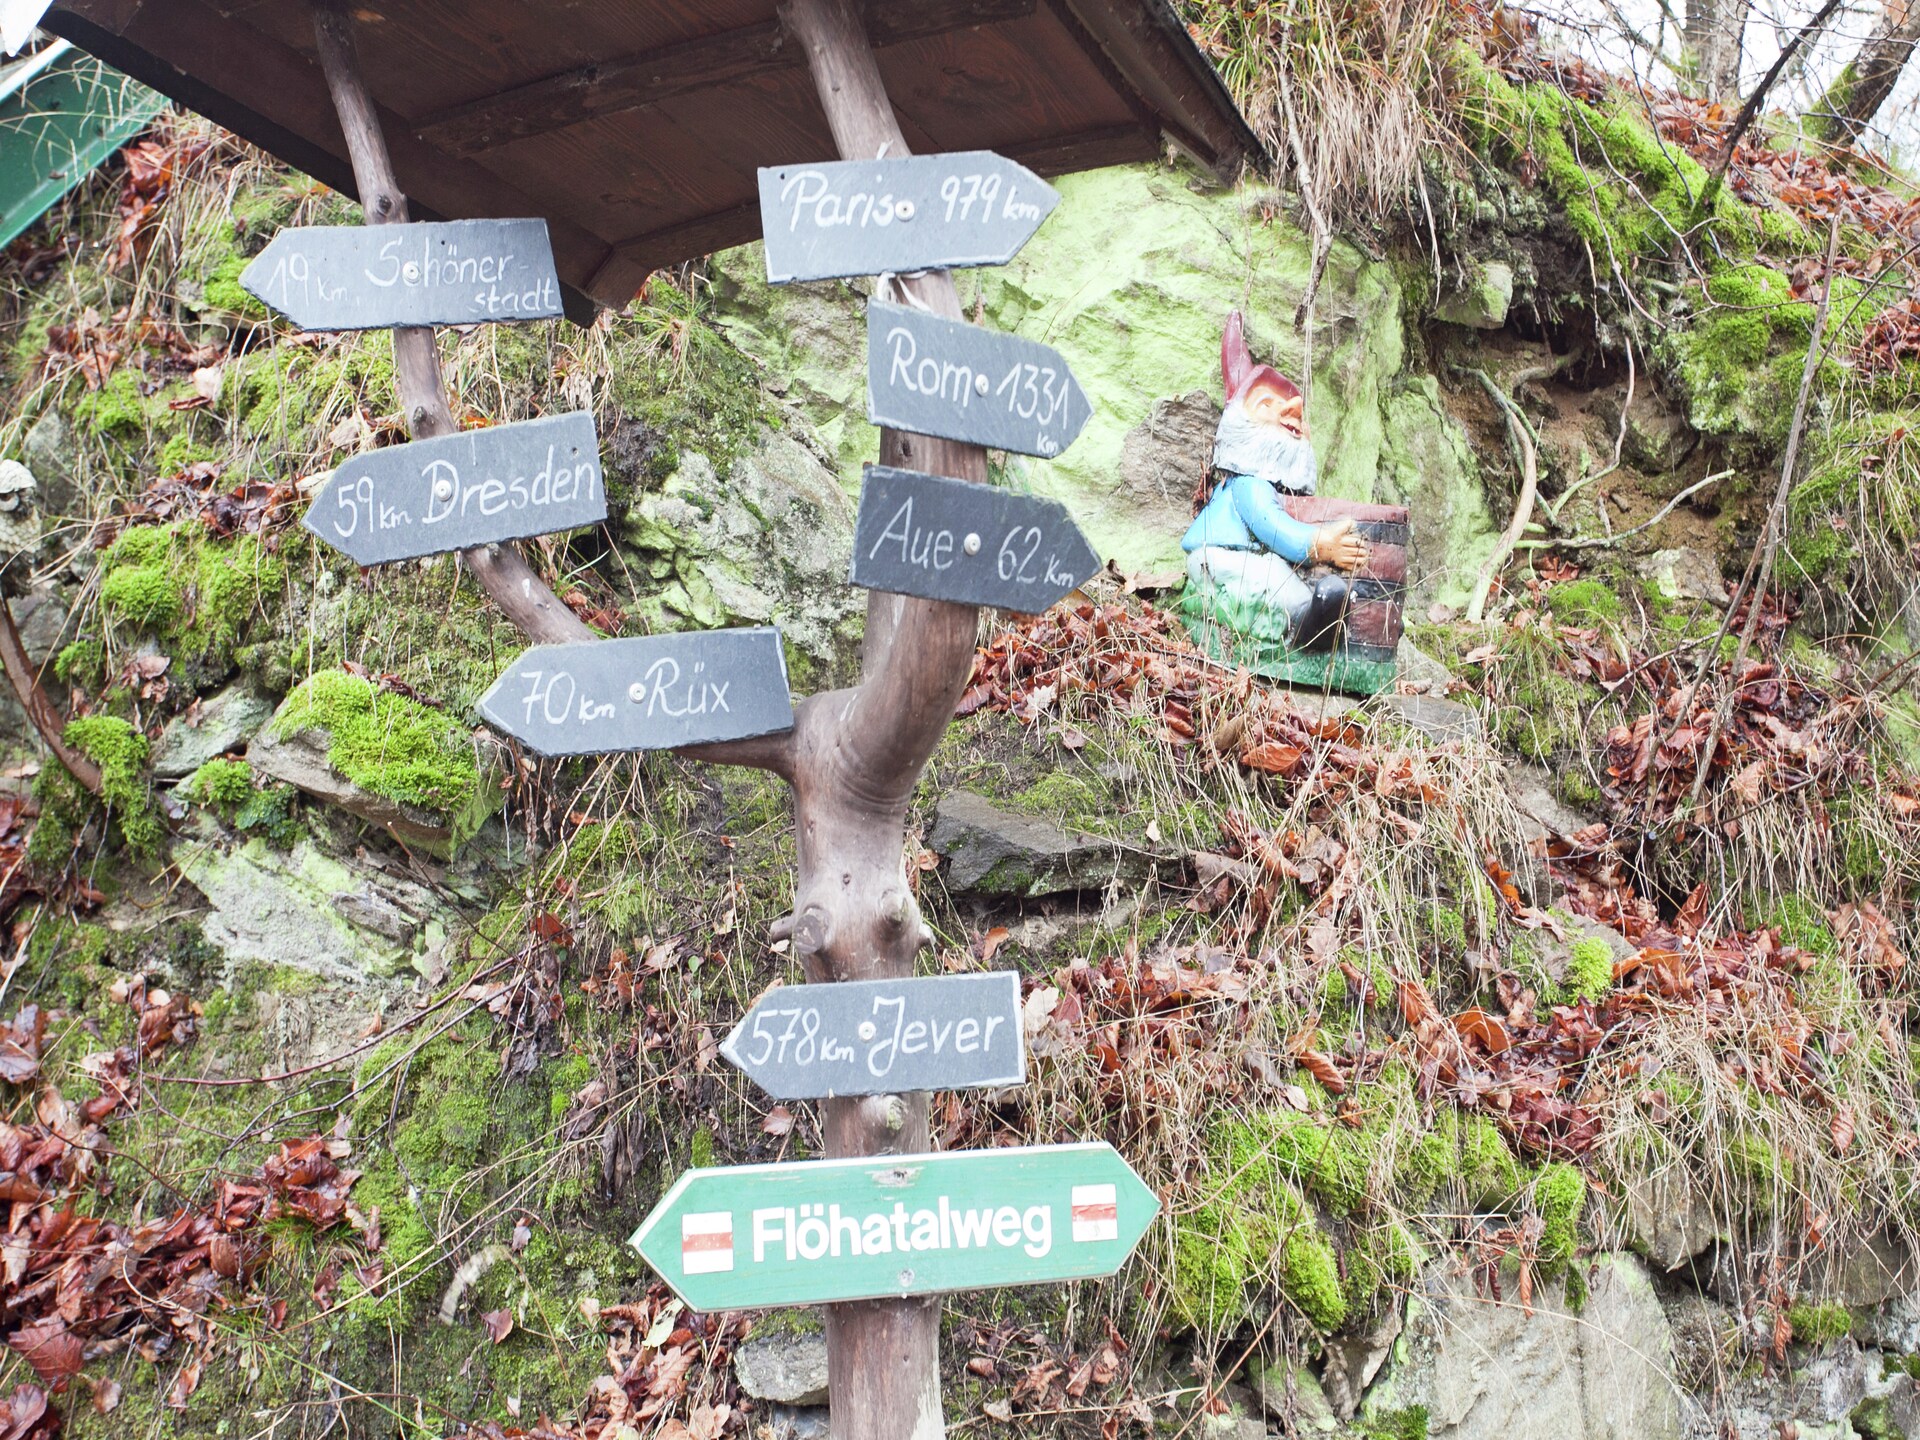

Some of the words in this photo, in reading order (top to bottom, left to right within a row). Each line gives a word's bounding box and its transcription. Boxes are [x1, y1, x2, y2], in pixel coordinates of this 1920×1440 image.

[780, 170, 895, 232] Paris
[940, 173, 1002, 224] 979
[1002, 184, 1041, 223] km
[266, 252, 310, 306] 19
[468, 278, 557, 313] stadt
[887, 327, 972, 407] Rom
[996, 362, 1071, 430] 1331
[333, 476, 376, 538] 59
[421, 444, 595, 525] Dresden
[869, 496, 954, 572] Aue
[998, 526, 1043, 584] 62
[520, 671, 577, 726] 70
[643, 656, 731, 718] Rüx
[746, 1008, 822, 1066] 578
[866, 995, 1005, 1078] Jever
[752, 1195, 1053, 1264] Flöhatalweg
